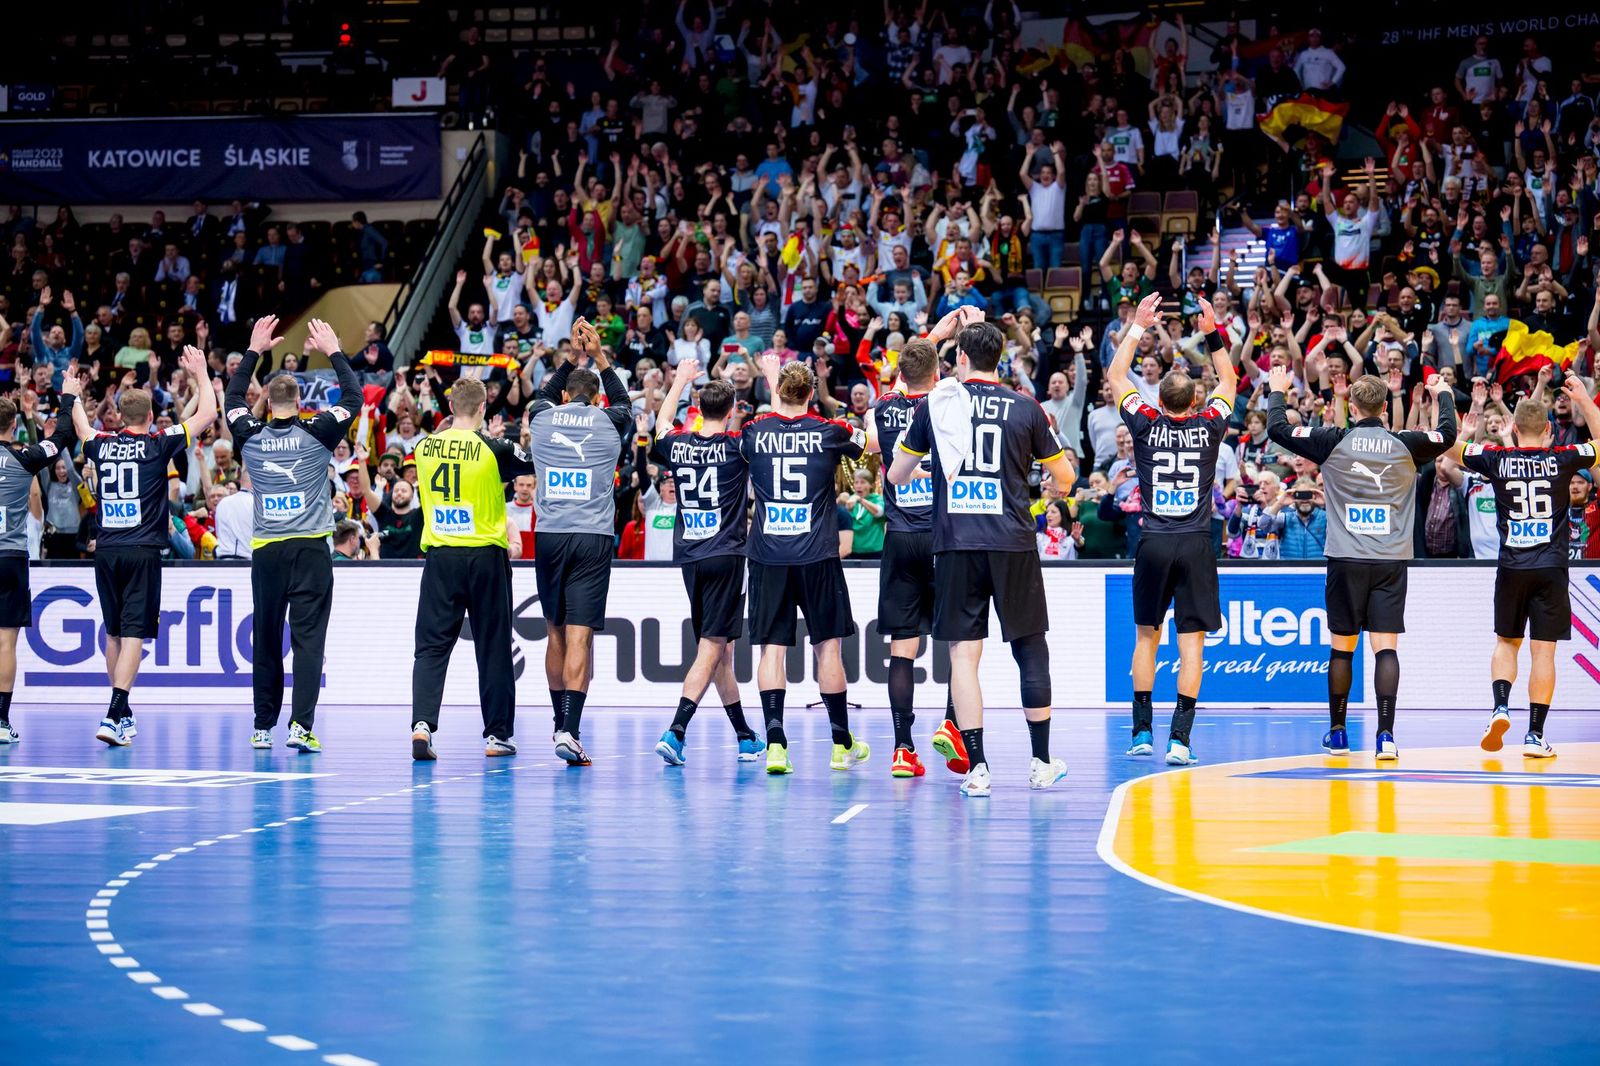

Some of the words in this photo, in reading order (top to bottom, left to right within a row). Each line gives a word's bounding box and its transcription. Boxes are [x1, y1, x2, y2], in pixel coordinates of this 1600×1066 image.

[1418, 27, 1441, 41] IHF
[1447, 22, 1494, 38] MEN'S
[1500, 16, 1559, 35] WORLD
[18, 92, 46, 101] GOLD
[411, 80, 427, 102] J
[35, 148, 63, 158] 2023
[88, 149, 201, 168] KATOWICE
[224, 144, 310, 171] ŚLĄSKIE
[12, 159, 63, 168] HANDBALL
[433, 351, 508, 366] DEUTSCHLAND
[970, 395, 1015, 421] NST
[551, 412, 594, 427] GERMANY
[261, 437, 300, 452] GERMANY
[755, 431, 823, 454] KNORR
[1147, 425, 1210, 448] HÄFNER
[1351, 437, 1393, 454] GERMANY
[98, 440, 146, 461] WEBER
[422, 437, 482, 462] BIRLEHM
[670, 441, 727, 465] GROETZKI
[1152, 451, 1201, 490] 25
[1498, 456, 1559, 479] MERTENS
[100, 462, 140, 500] 20
[430, 463, 462, 502] 41
[548, 471, 588, 488] DKB
[676, 466, 720, 508] 24
[772, 457, 809, 501] 15
[951, 480, 998, 500] DKB
[1155, 489, 1196, 506] DKB
[1505, 479, 1553, 520] 36
[104, 502, 137, 519] DKB
[265, 495, 302, 511] DKB
[951, 501, 964, 509] Das
[982, 502, 997, 510] Bank
[435, 508, 471, 525] DKB
[684, 511, 718, 529] DKB
[768, 506, 807, 523] DKB
[1348, 507, 1386, 524] DKB
[1510, 521, 1549, 537] DKB
[1213, 652, 1267, 674] real
[1265, 659, 1329, 682] game
